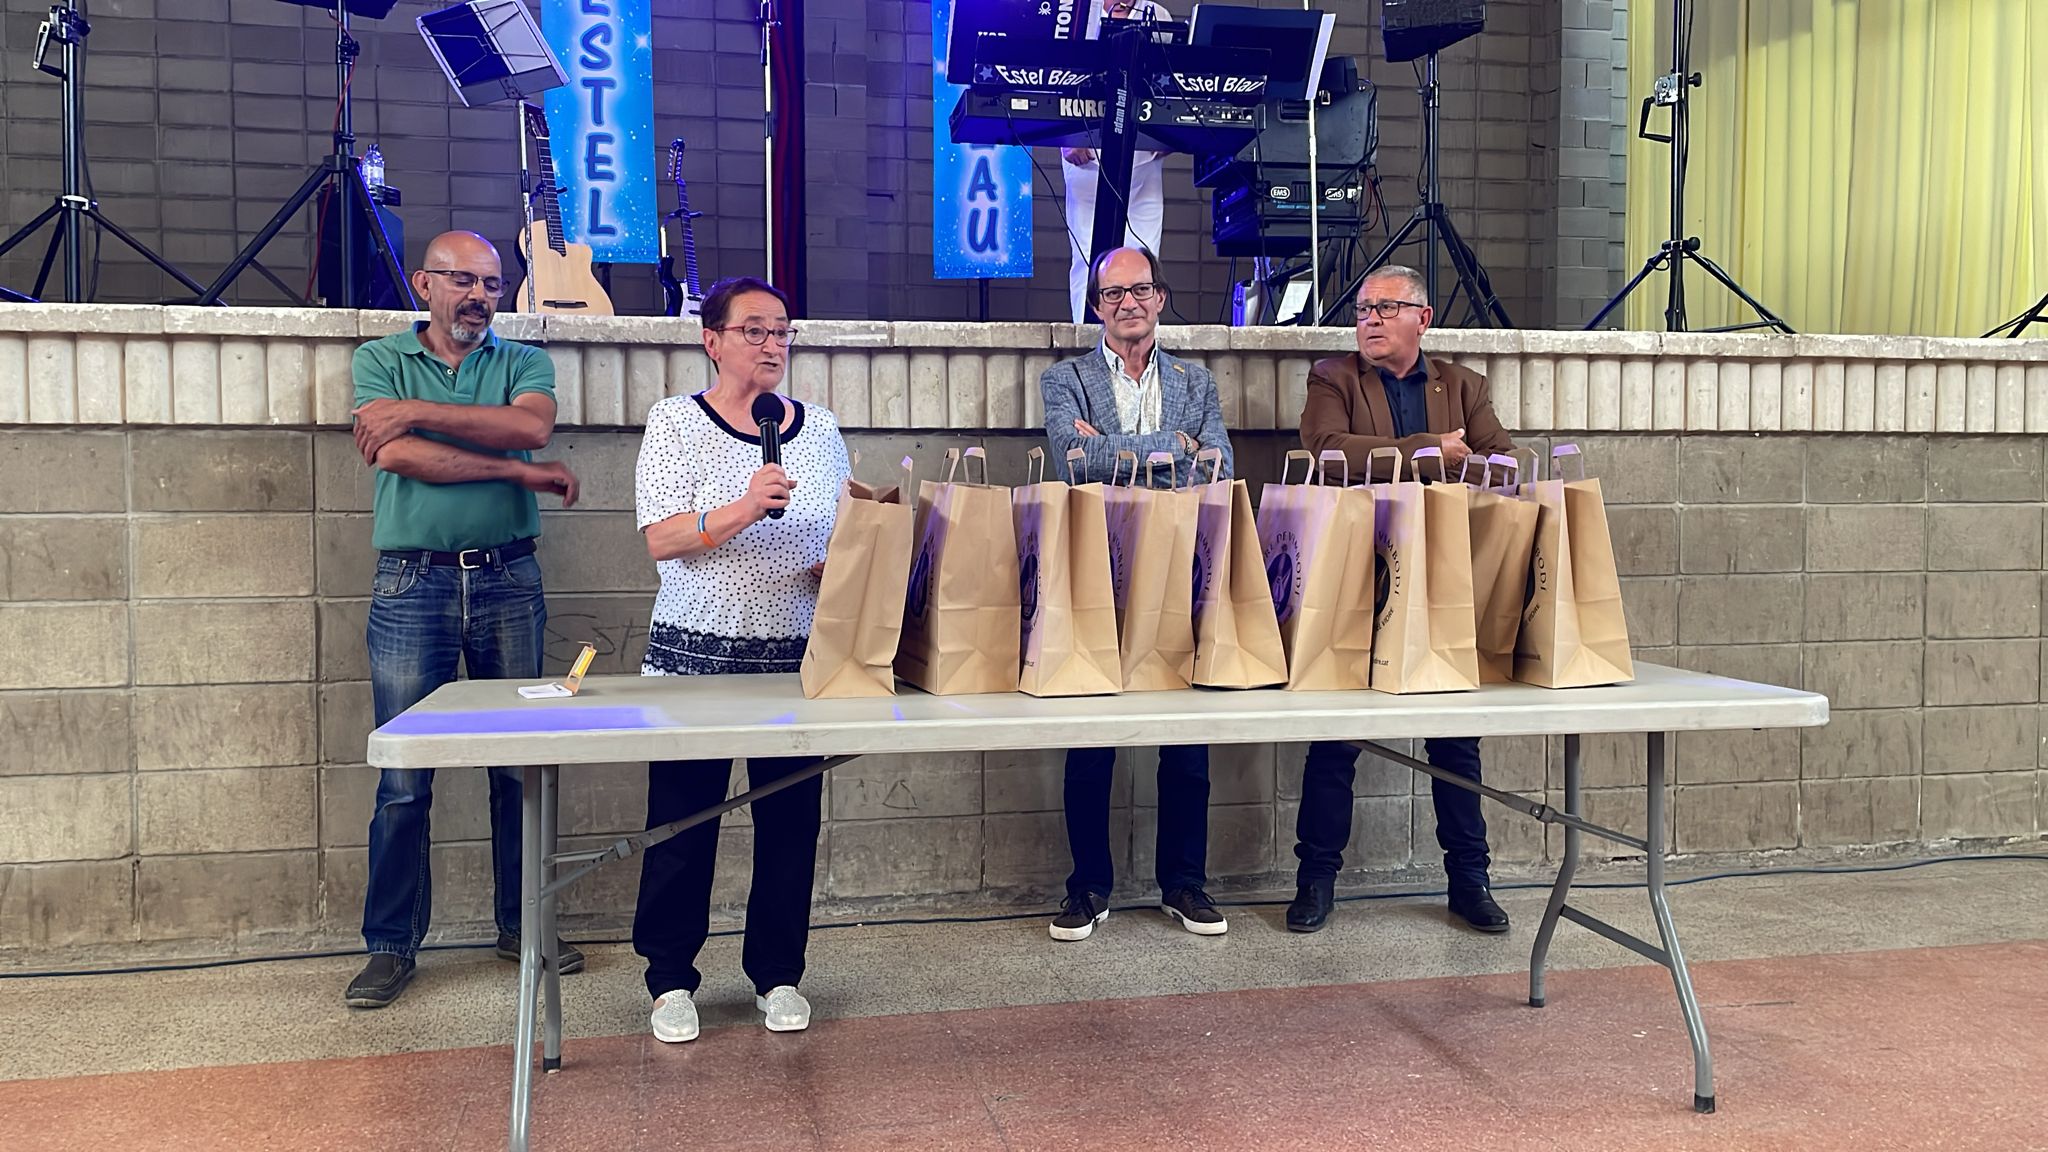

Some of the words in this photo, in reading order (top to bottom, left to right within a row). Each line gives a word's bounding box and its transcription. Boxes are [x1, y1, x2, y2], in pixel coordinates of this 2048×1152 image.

[995, 65, 1043, 84] Estel
[1048, 70, 1091, 85] Blau
[1173, 72, 1219, 92] Estel
[1223, 76, 1264, 92] Blau
[1114, 108, 1125, 134] adam
[1139, 101, 1152, 122] 3
[967, 144, 999, 253] AU
